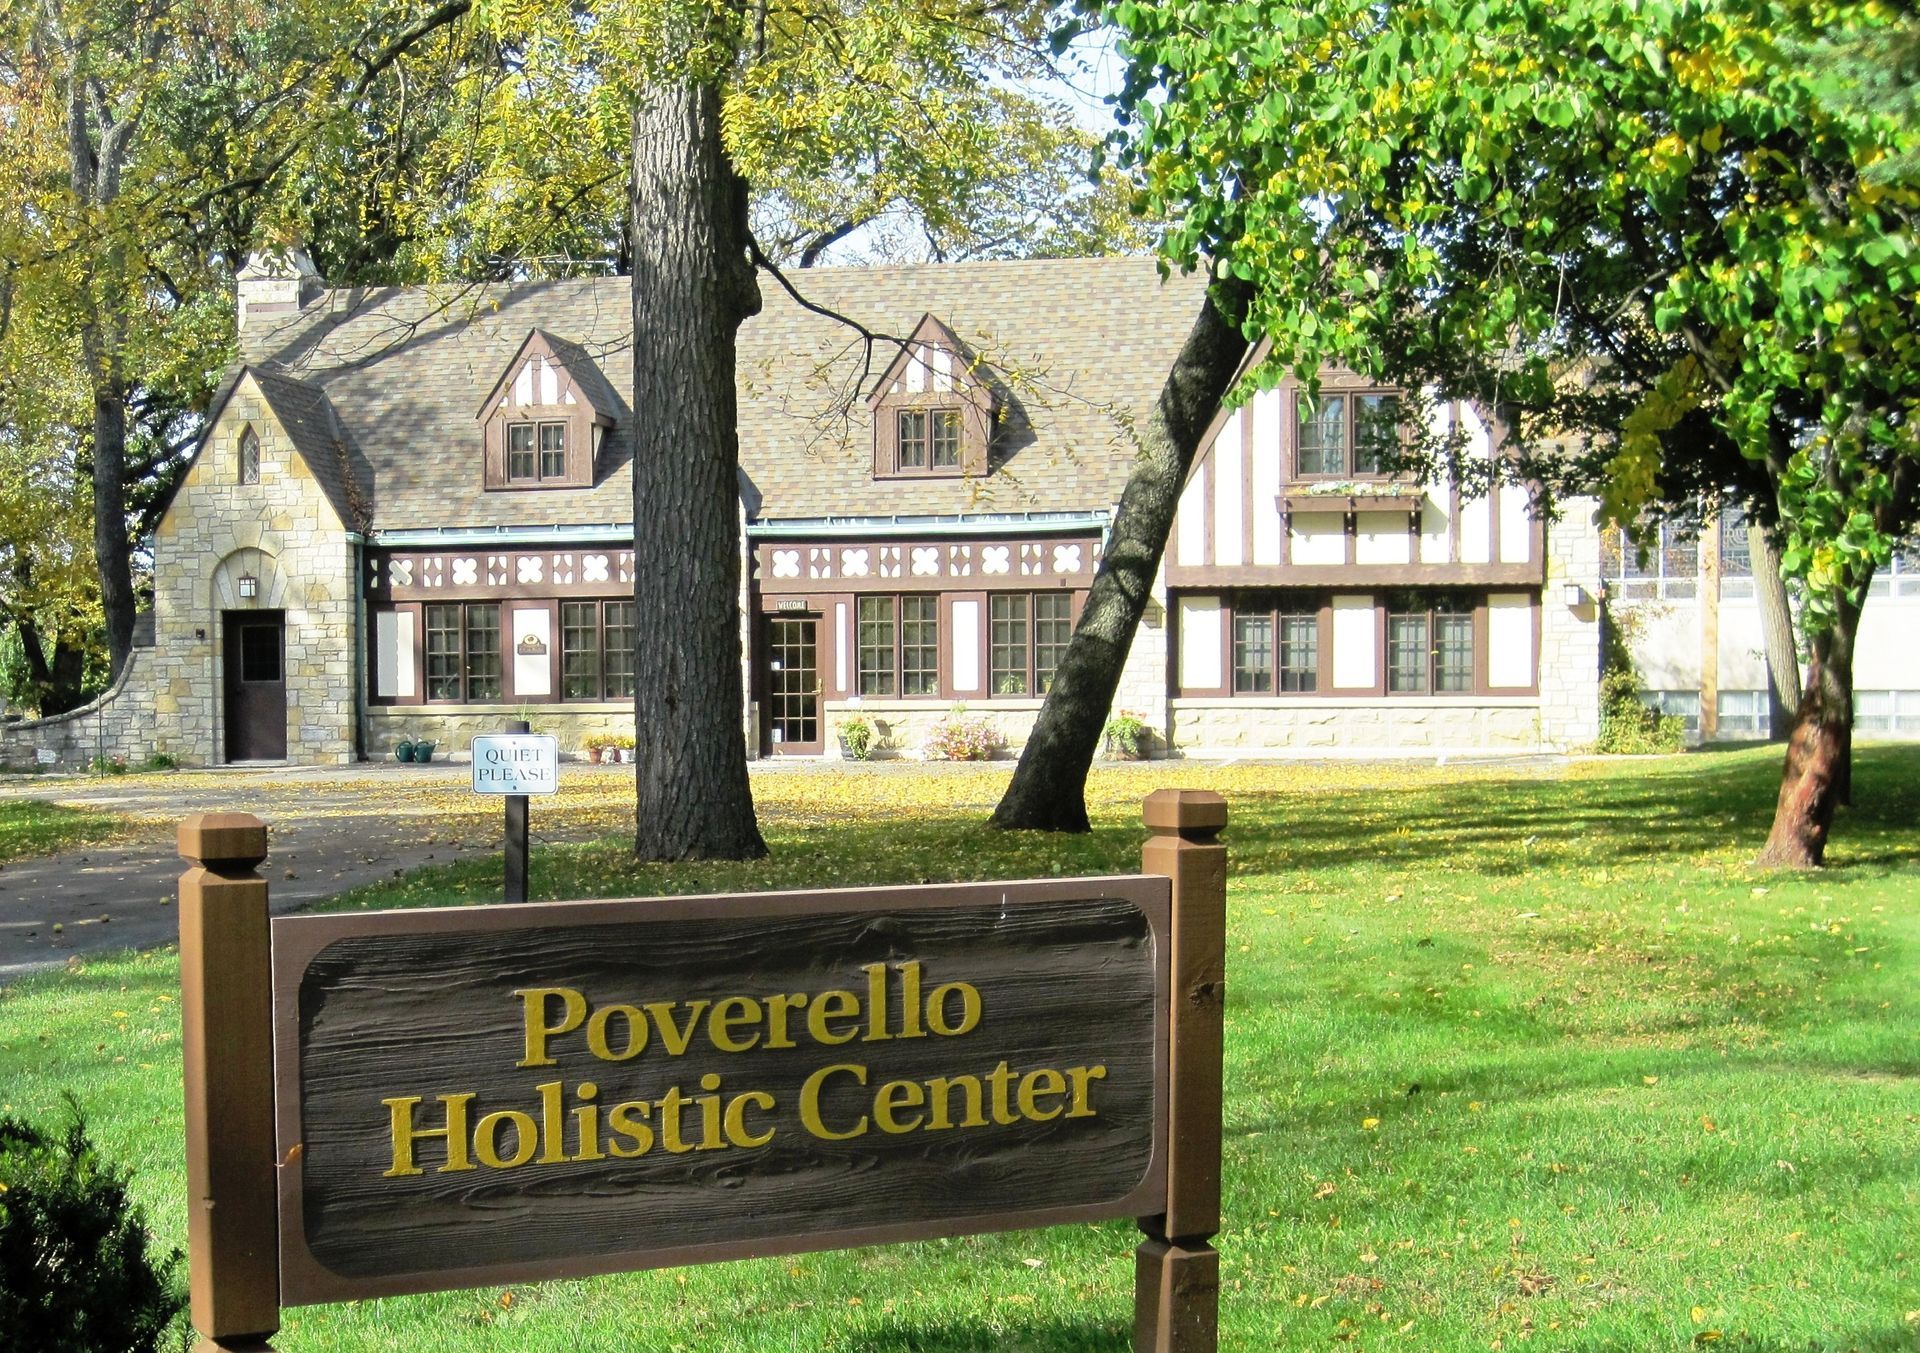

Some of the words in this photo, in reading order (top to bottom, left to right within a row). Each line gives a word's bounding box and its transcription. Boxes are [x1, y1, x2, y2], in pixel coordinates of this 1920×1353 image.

[778, 601, 805, 609] WELCOME
[486, 748, 543, 764] QUIET
[479, 768, 551, 781] PLEASE
[513, 960, 981, 1068] Poverello
[381, 1073, 776, 1177] Holistic
[800, 1060, 1107, 1140] Center
